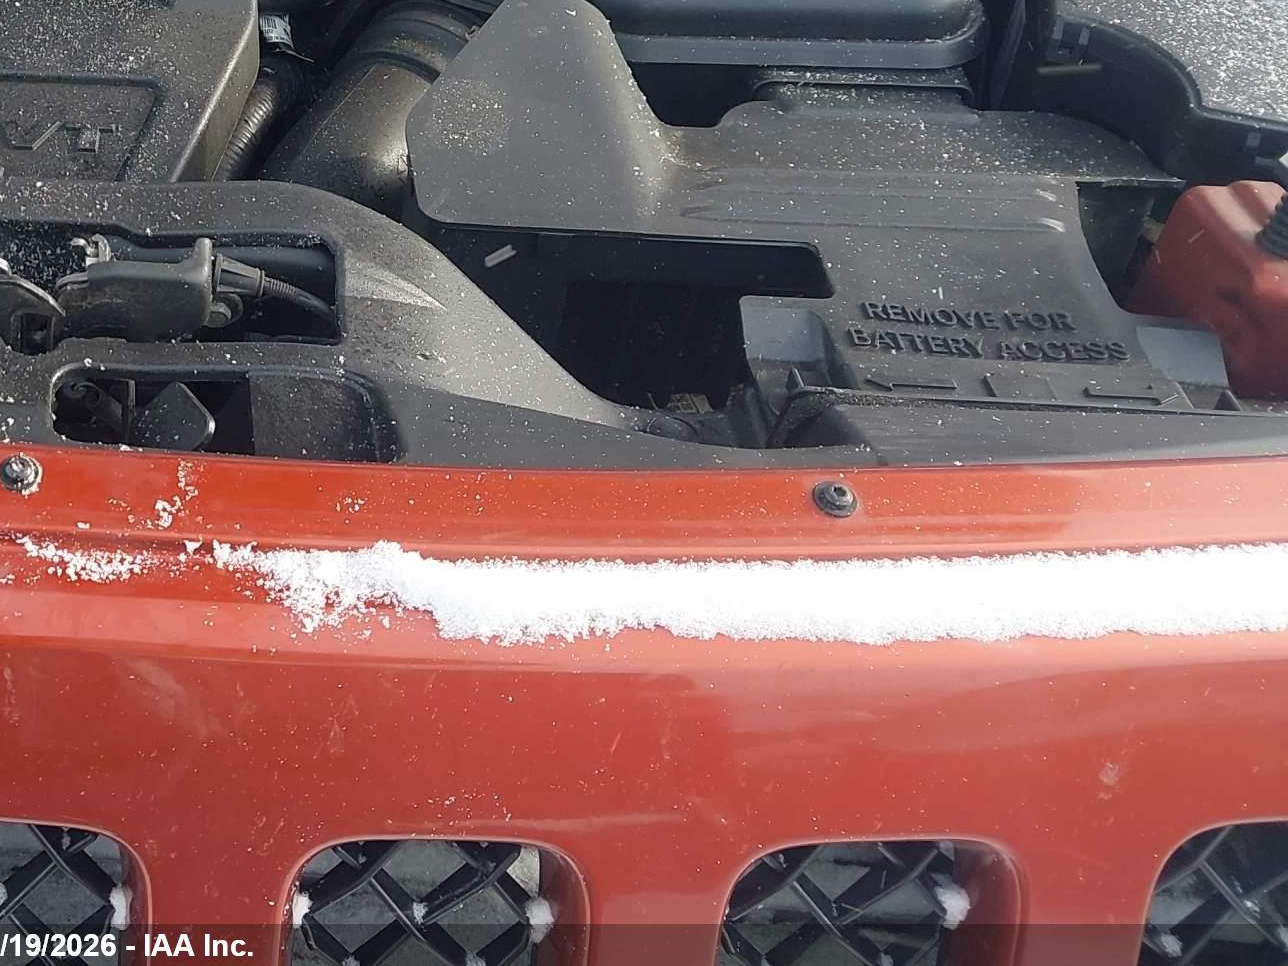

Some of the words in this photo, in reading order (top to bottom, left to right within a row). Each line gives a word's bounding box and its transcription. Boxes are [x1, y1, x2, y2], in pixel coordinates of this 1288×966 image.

[860, 301, 1001, 330] REMOVE
[1003, 311, 1077, 332] FOR
[847, 327, 986, 358] BATTERY
[1000, 341, 1131, 362] ACCESS
